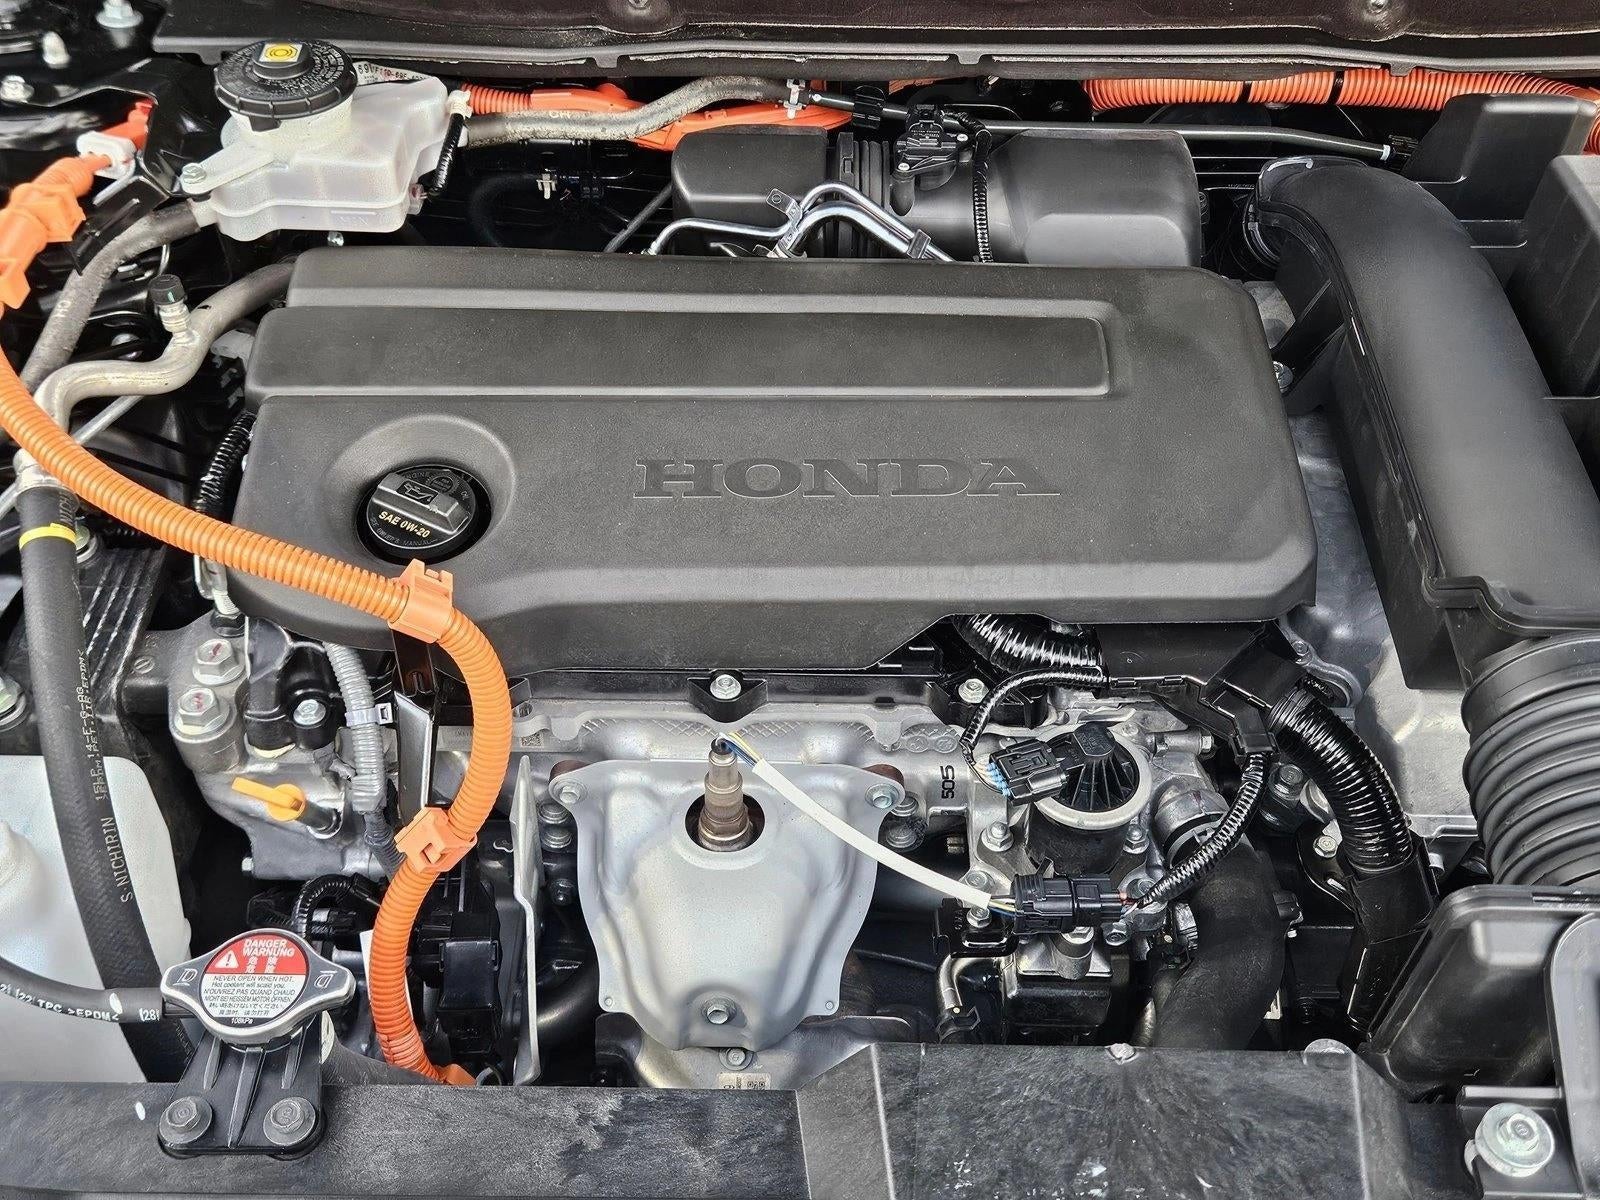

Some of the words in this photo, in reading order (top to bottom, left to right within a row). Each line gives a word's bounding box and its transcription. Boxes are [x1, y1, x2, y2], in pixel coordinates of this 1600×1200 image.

[632, 458, 1062, 498] HONDA
[378, 510, 402, 526] SAE
[400, 520, 431, 539] 0W-20
[940, 764, 956, 799] 505
[243, 939, 288, 949] DANGER
[242, 946, 296, 958] WARNUNG
[279, 975, 295, 983] HOT.
[37, 998, 62, 1013] TPC
